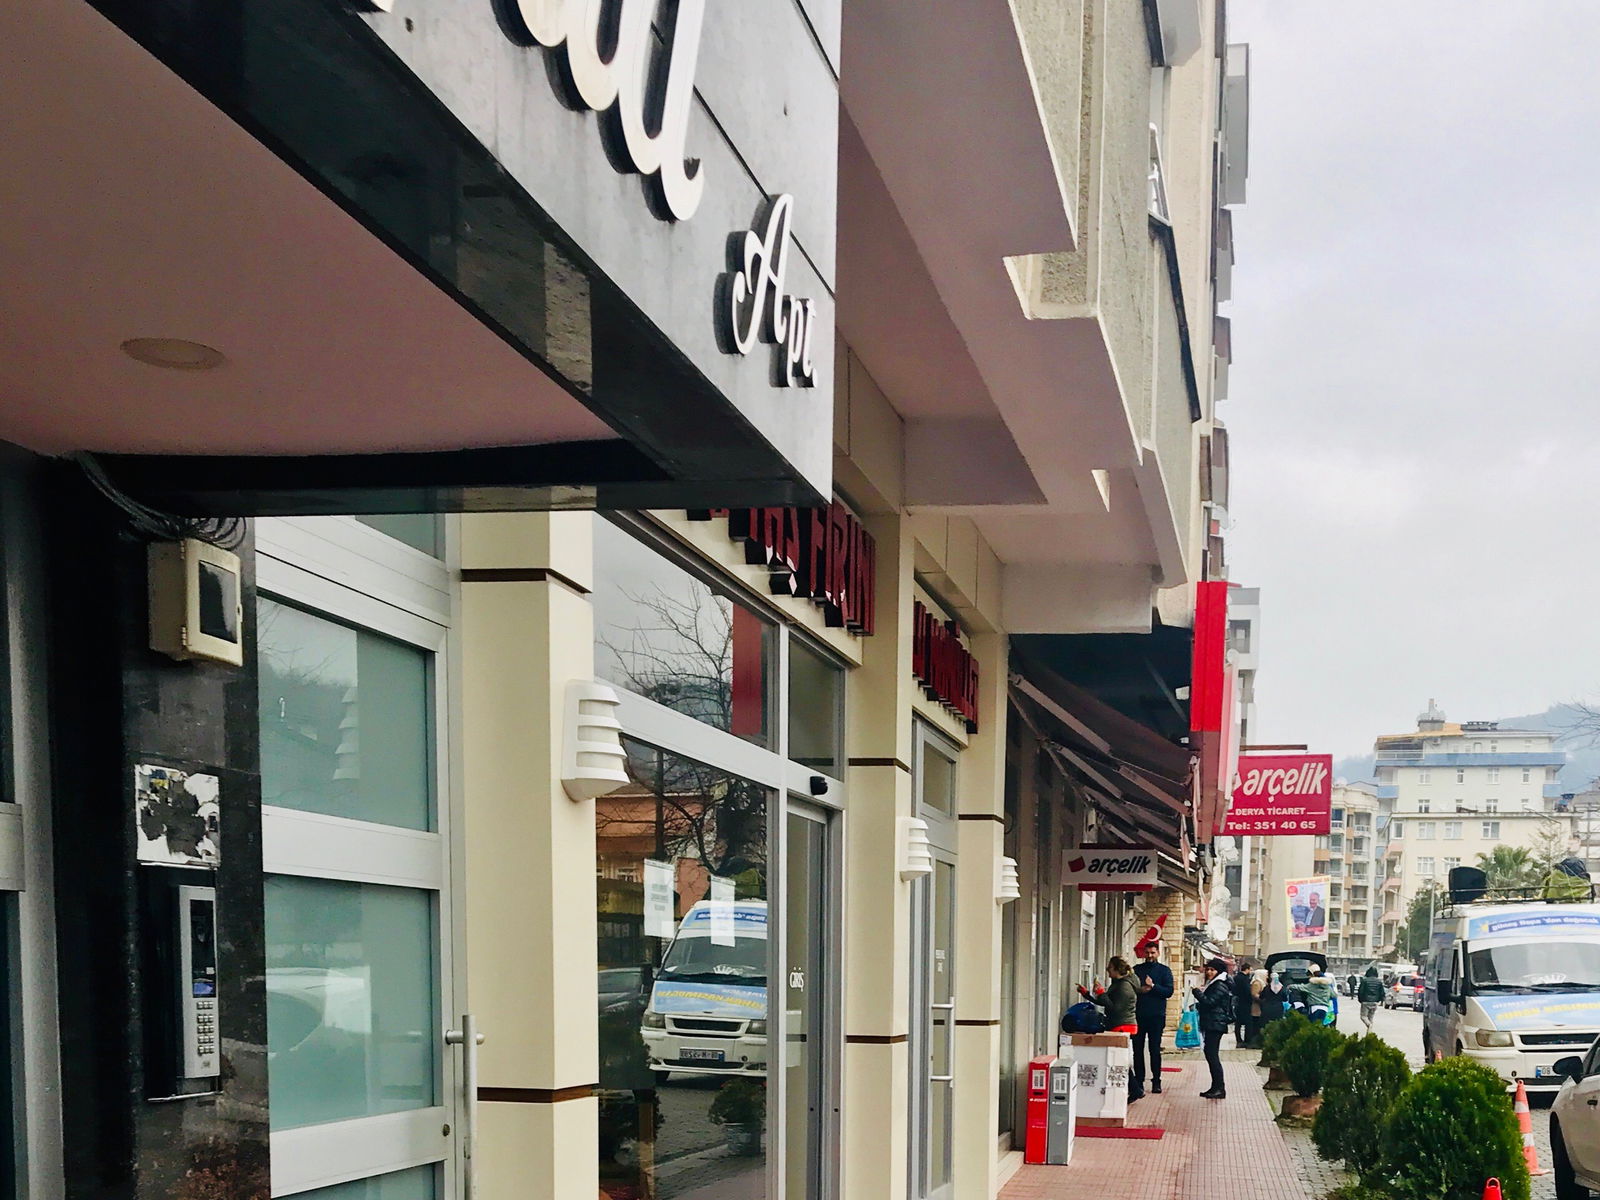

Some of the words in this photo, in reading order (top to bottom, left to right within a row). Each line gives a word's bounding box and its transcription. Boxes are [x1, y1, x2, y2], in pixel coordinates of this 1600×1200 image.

[1242, 763, 1328, 803] arçelik
[1235, 808, 1265, 816] DERYA
[1267, 806, 1306, 815] TİCARET
[1227, 821, 1250, 830] Tel:
[1254, 821, 1276, 830] 351
[1280, 821, 1297, 830] 40
[1300, 820, 1317, 829] 65
[1088, 856, 1151, 877] arçelik
